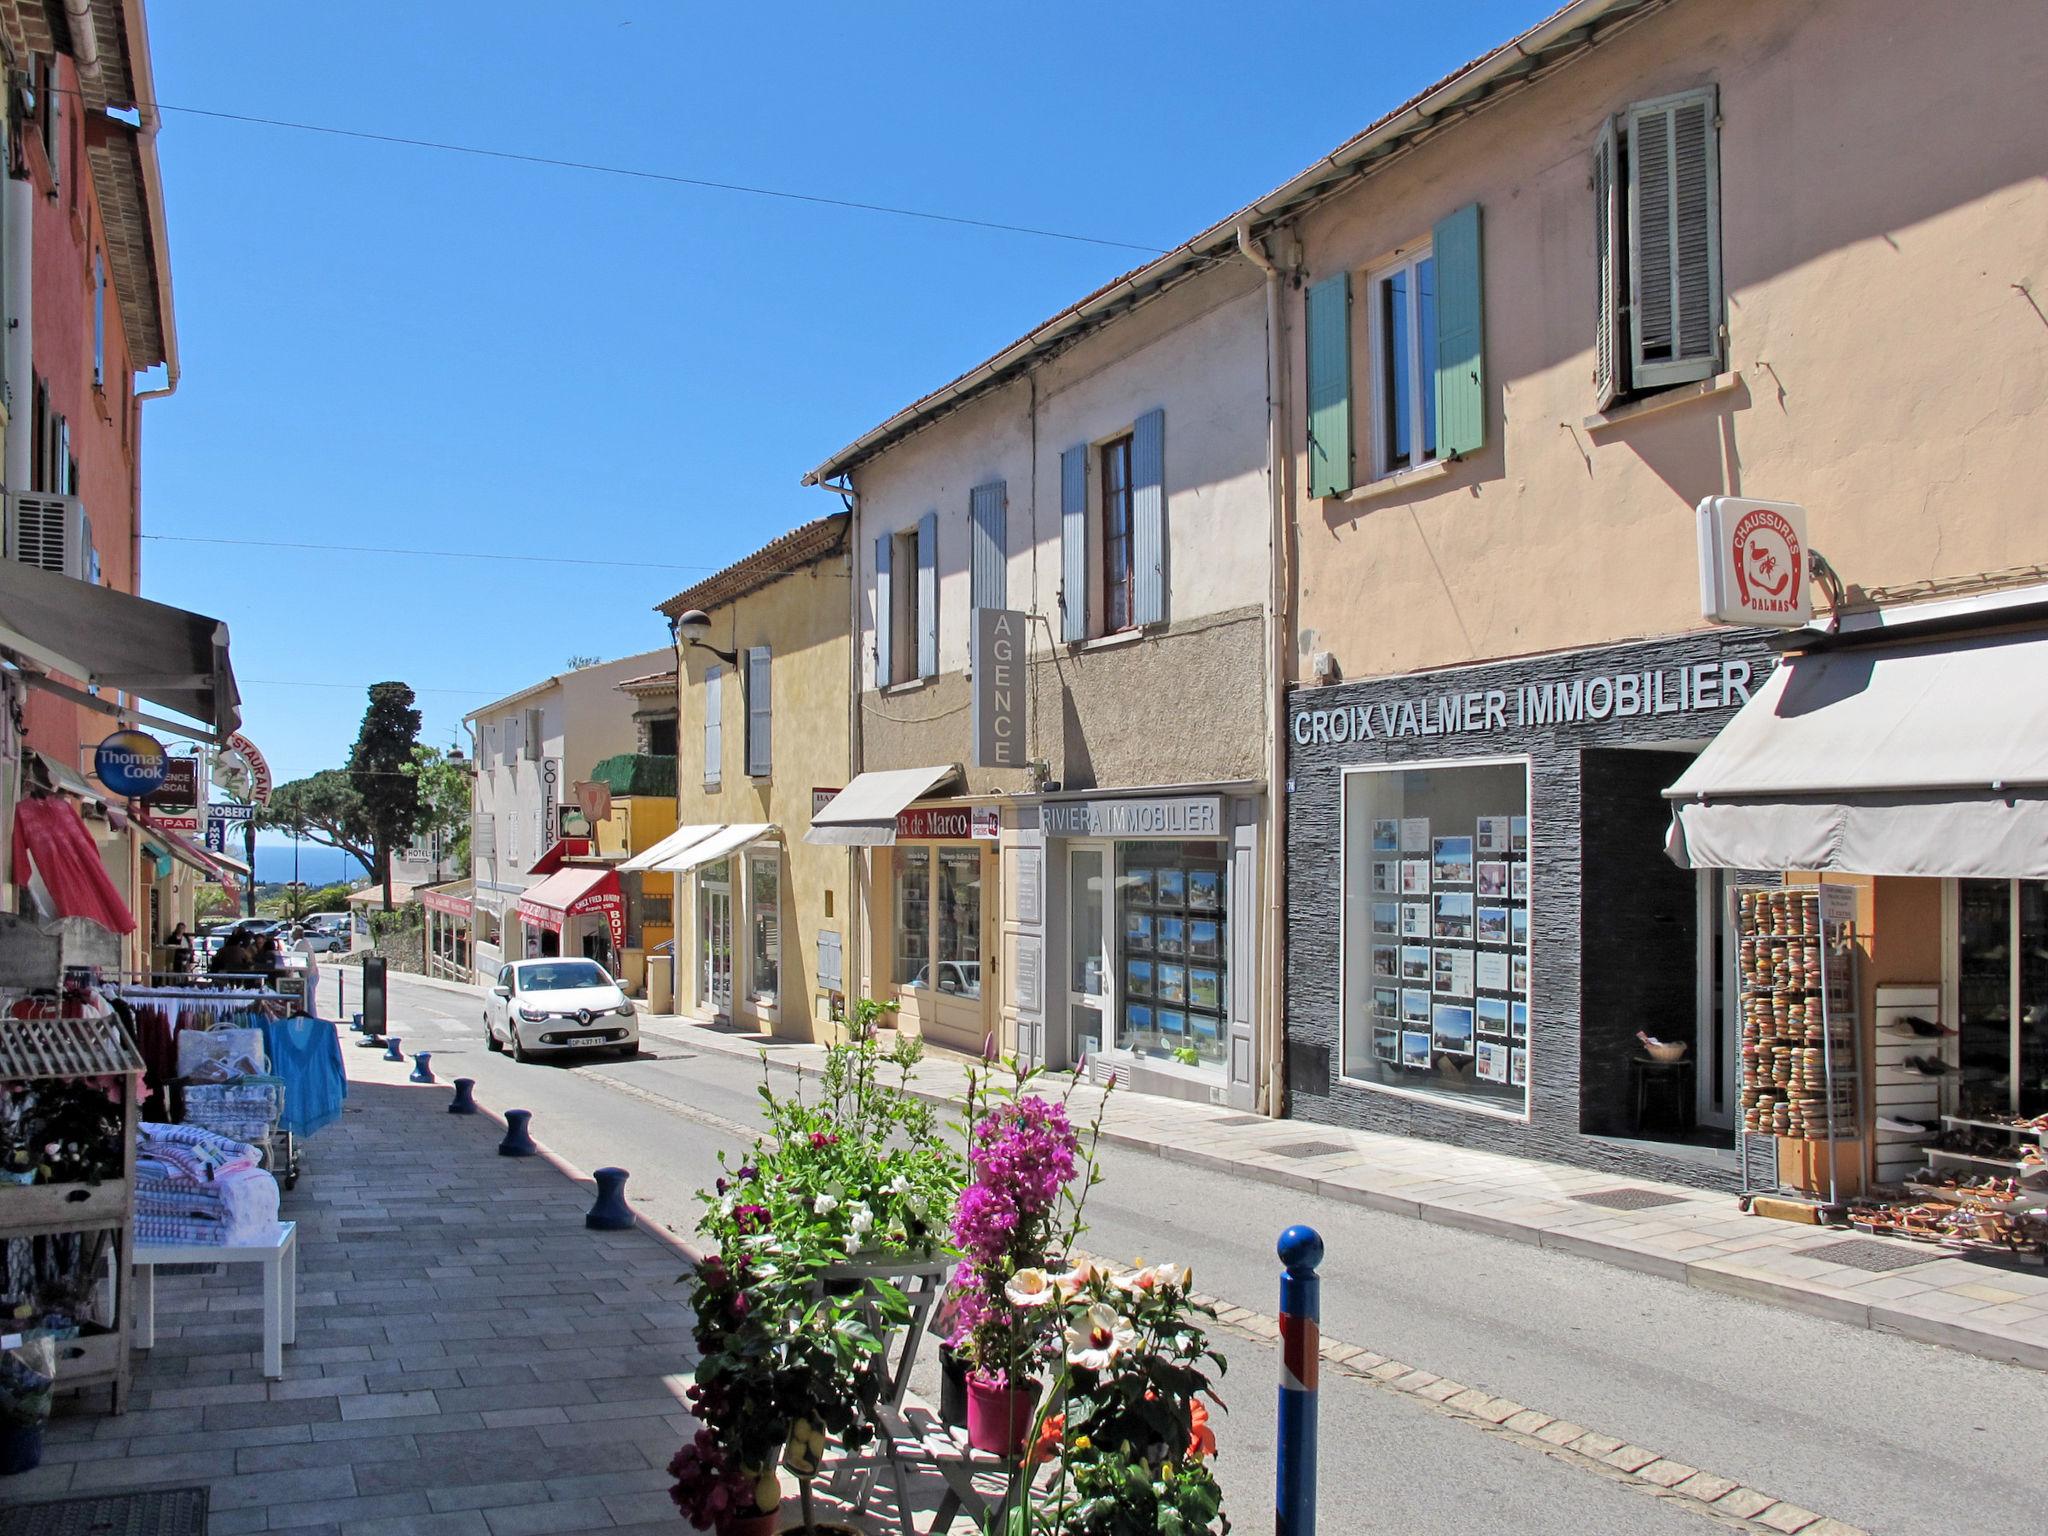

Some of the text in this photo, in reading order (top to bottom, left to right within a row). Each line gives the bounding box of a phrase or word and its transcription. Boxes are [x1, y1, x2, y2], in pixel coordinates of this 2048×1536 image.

[1734, 513, 1799, 555] CHAUSSURES
[1752, 598, 1790, 612] DALMAS
[994, 614, 1012, 763] AGENCE
[1295, 661, 1752, 745] CROIX VALMER IMMOBILIER
[99, 750, 164, 766] Thomas
[124, 764, 163, 778] Cook
[232, 734, 267, 806] STAURANT
[207, 806, 252, 818] ROBERT
[911, 814, 923, 835] de
[926, 811, 967, 835] Marco
[1042, 804, 1214, 833] RIVIERA IMMOBILIER
